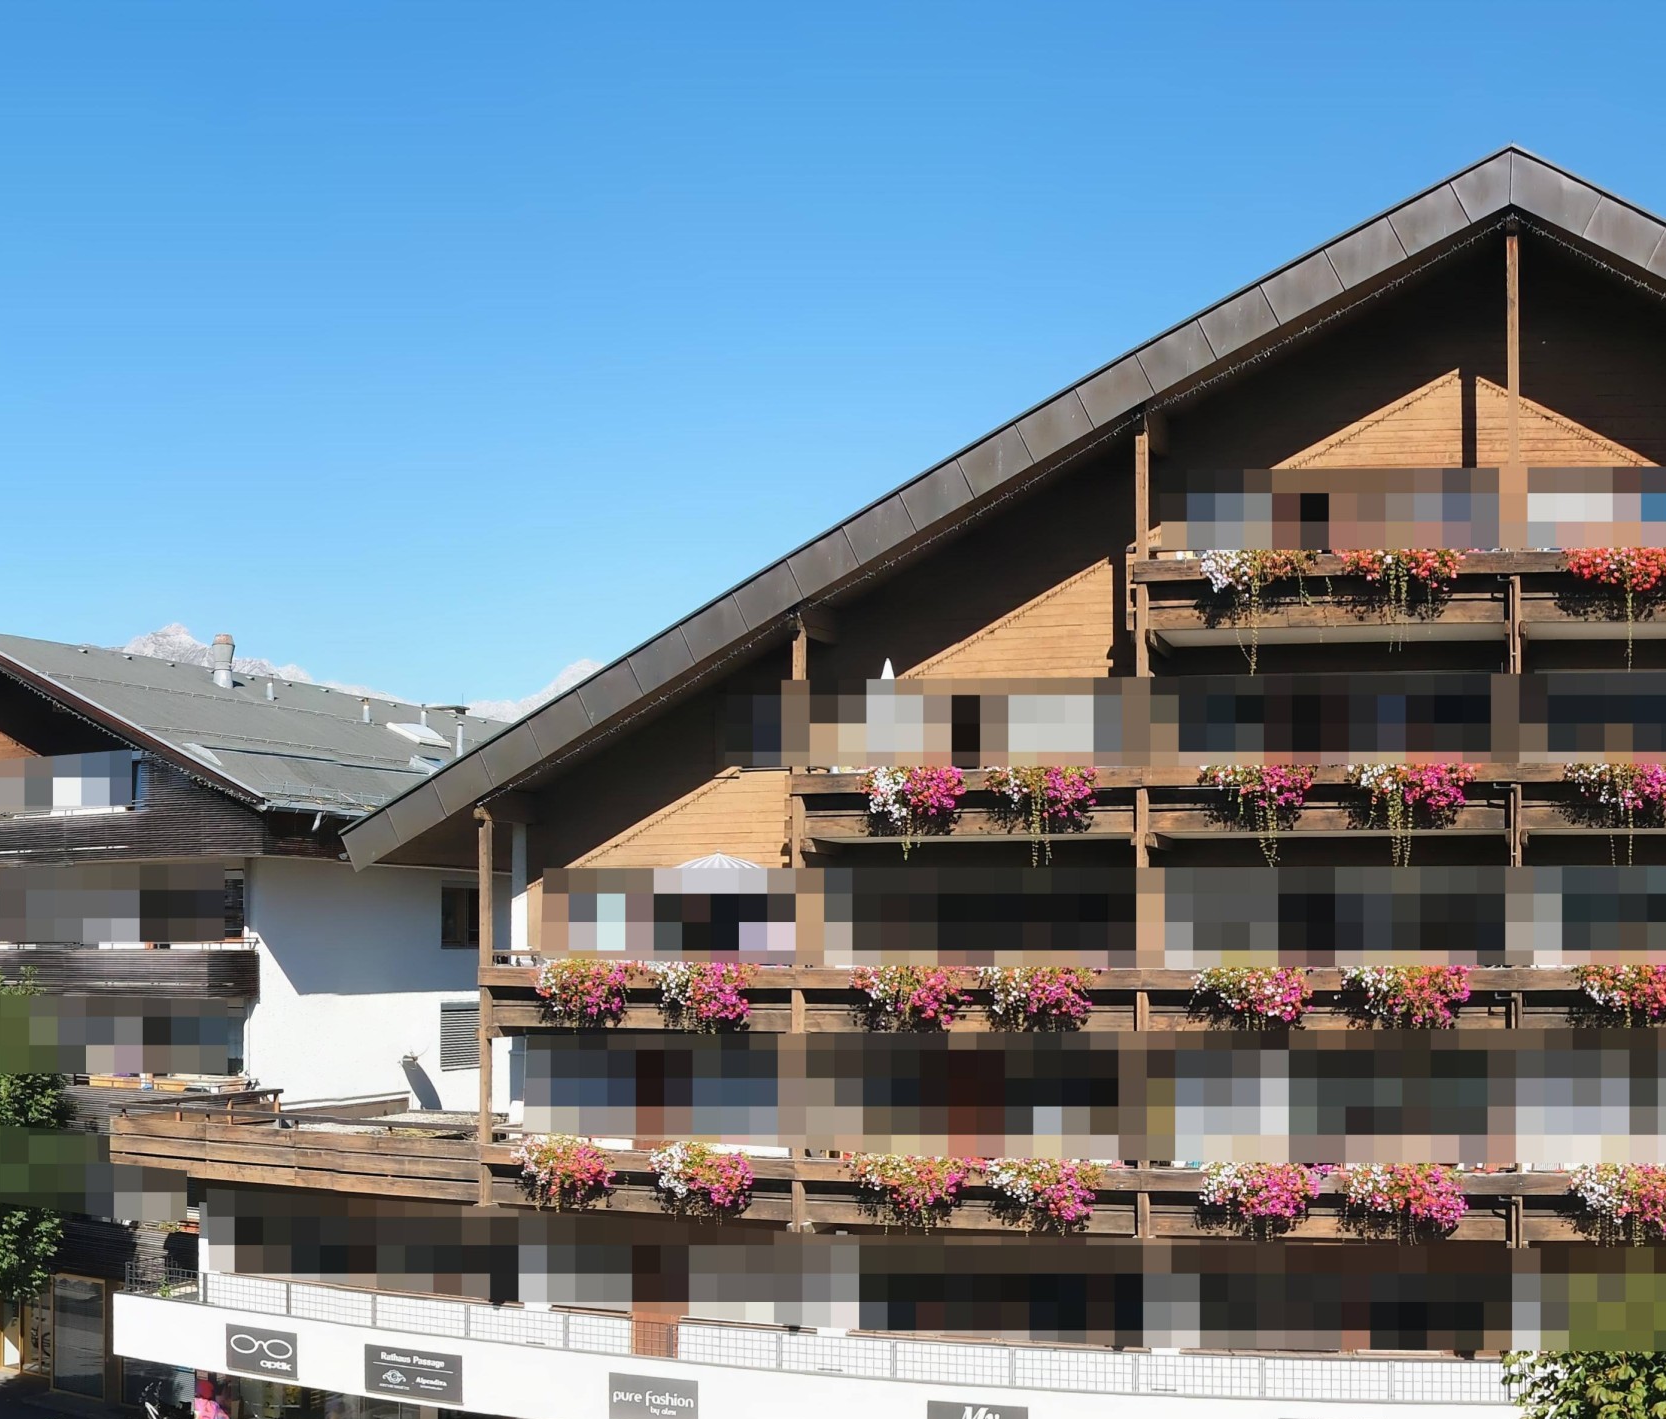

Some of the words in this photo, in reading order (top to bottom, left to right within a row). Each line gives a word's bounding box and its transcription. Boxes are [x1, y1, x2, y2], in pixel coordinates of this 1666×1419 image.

[260, 1360, 292, 1372] optik
[380, 1351, 411, 1364] Rathaus
[413, 1355, 445, 1368] Passage
[613, 1390, 643, 1403] pure
[645, 1390, 694, 1408] fashion
[650, 1406, 660, 1416] by
[661, 1408, 677, 1416] alex
